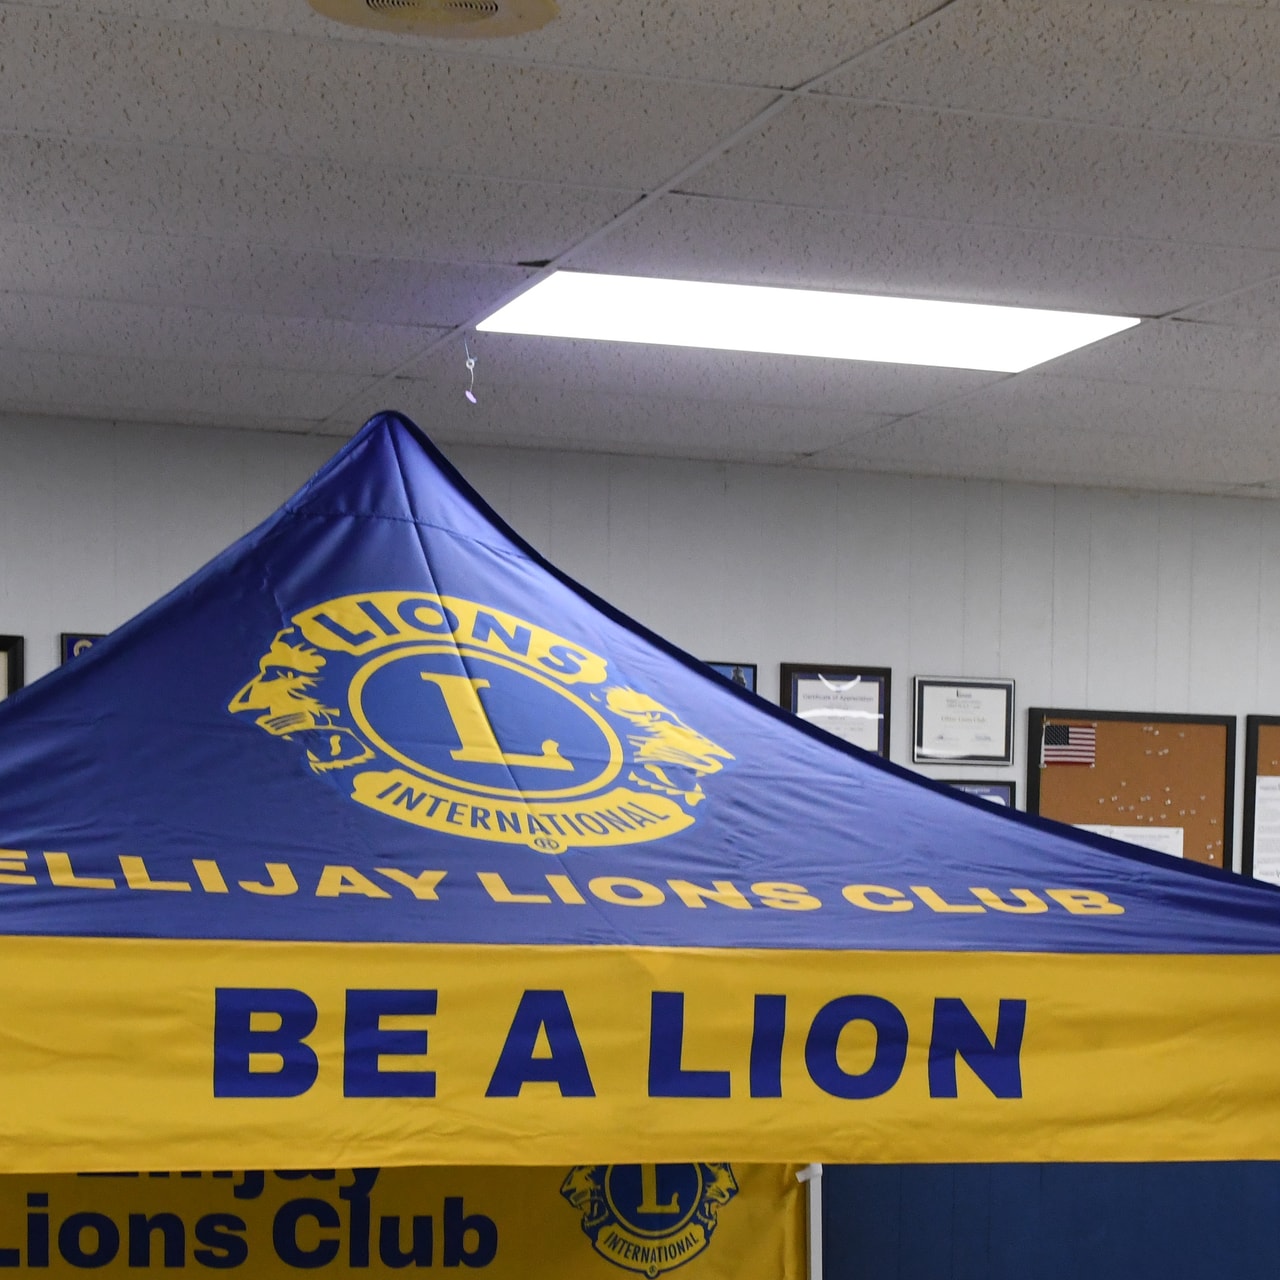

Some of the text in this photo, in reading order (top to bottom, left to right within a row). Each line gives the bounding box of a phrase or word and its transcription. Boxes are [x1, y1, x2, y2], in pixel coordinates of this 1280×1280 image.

[312, 597, 589, 675] LIONS
[420, 672, 575, 771] L
[375, 781, 671, 838] INTERNATIONAL
[476, 872, 822, 911] LIONS
[841, 884, 1125, 915] CLUB
[213, 986, 1027, 1100] BE A LION
[272, 1197, 498, 1268] Club
[603, 1231, 700, 1264] INTERNATIONAL
